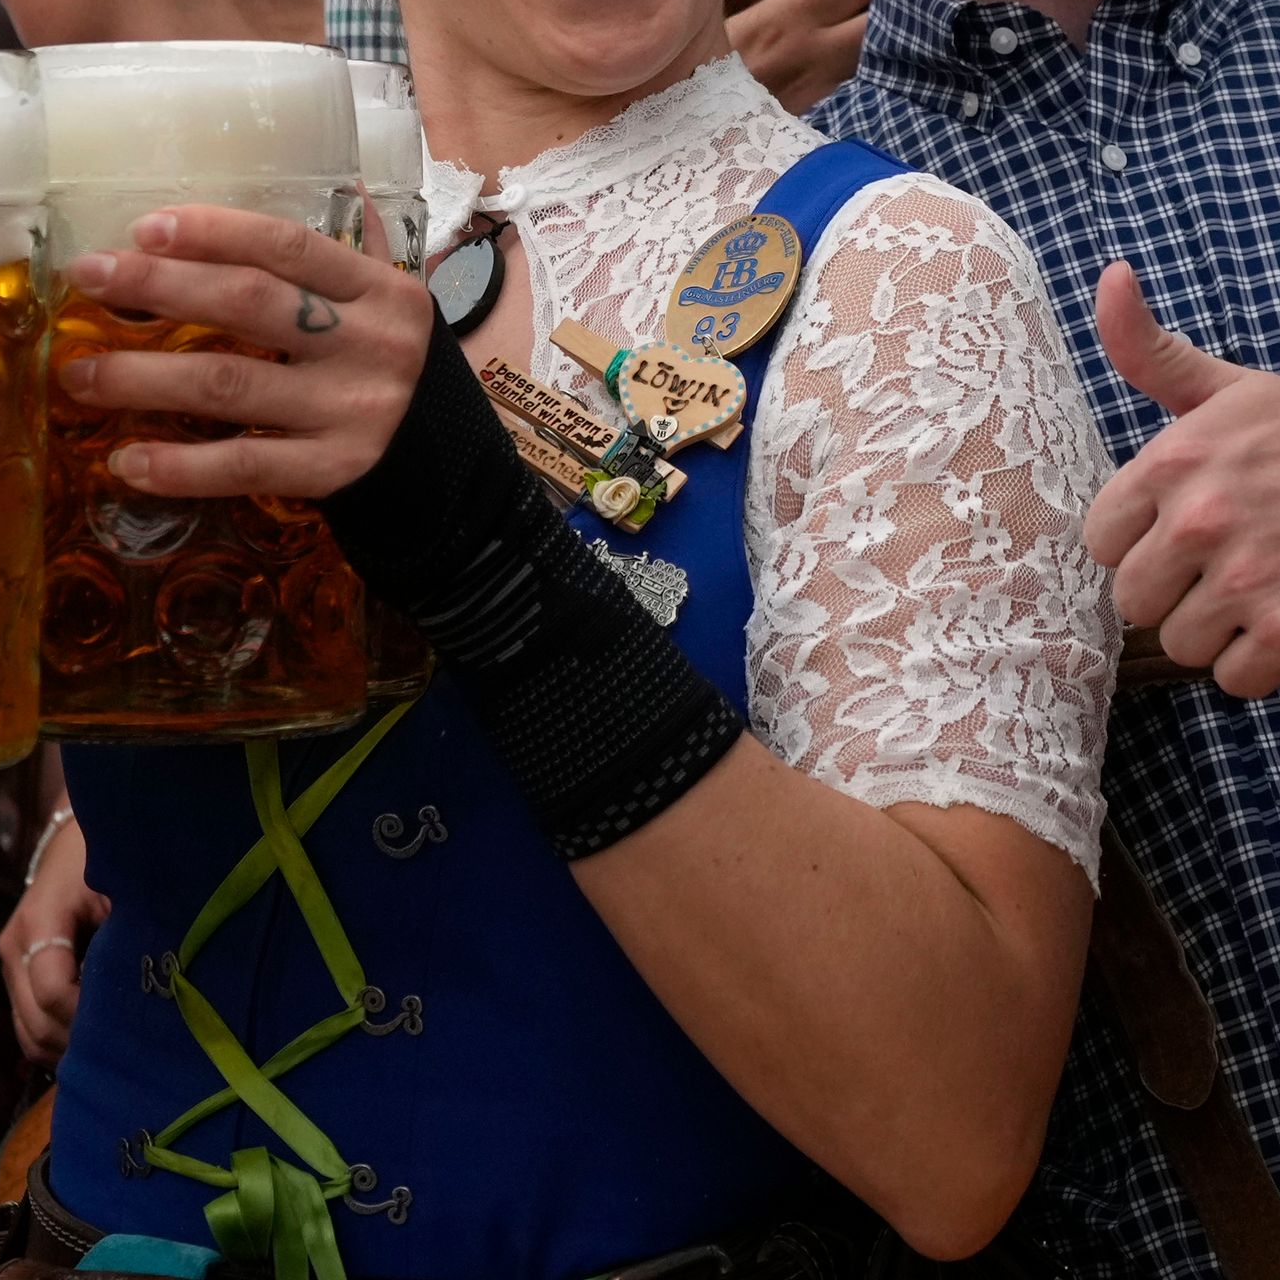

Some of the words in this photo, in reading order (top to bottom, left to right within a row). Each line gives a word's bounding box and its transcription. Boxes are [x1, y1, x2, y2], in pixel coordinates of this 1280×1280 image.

[710, 258, 759, 290] HB
[691, 311, 741, 345] 93
[490, 380, 541, 413] dunkel
[537, 408, 577, 437] wird!
[495, 363, 536, 394] beiss
[534, 390, 562, 413] nur,
[563, 407, 614, 444] wenn's
[633, 591, 673, 616] STZELT
